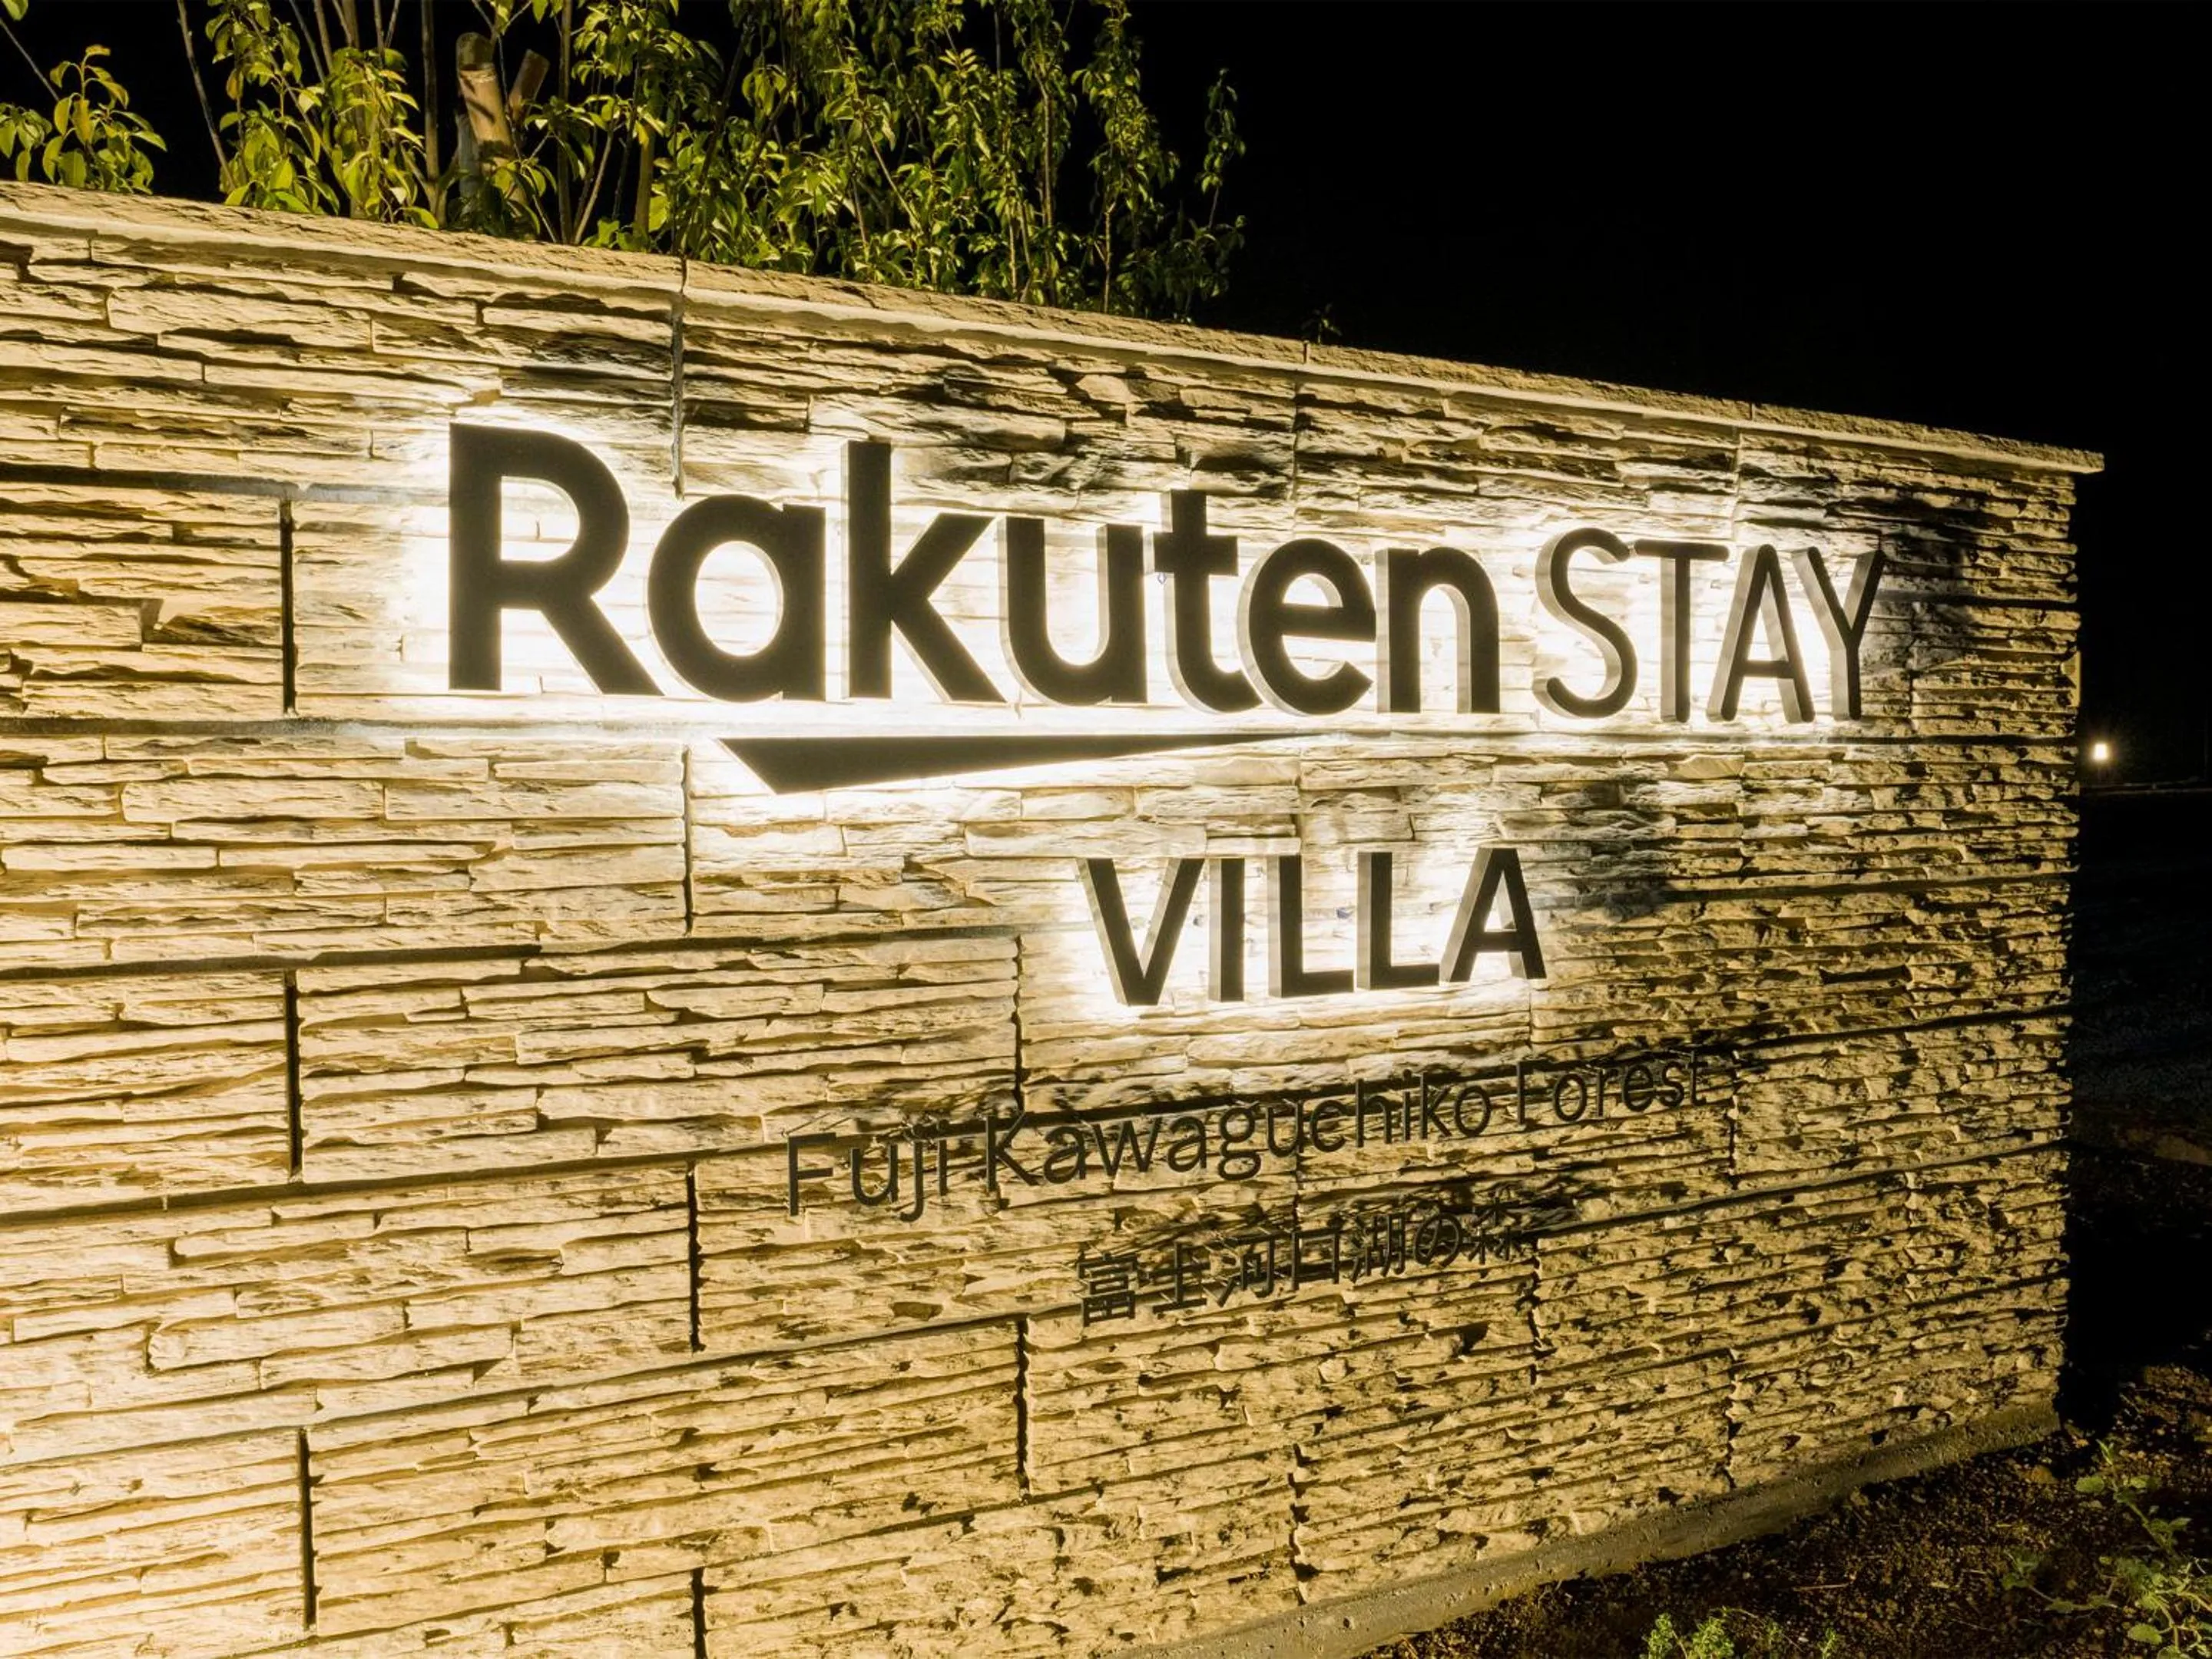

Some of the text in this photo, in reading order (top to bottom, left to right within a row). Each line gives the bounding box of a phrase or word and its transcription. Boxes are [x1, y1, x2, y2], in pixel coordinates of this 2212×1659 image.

[449, 422, 1886, 724] Rakuten STAY
[1076, 846, 1547, 1006] VILLA
[786, 1049, 1707, 1222] Fuji Kawaguchiko Forest
[1076, 1197, 1525, 1326] 富士河口湖の森
